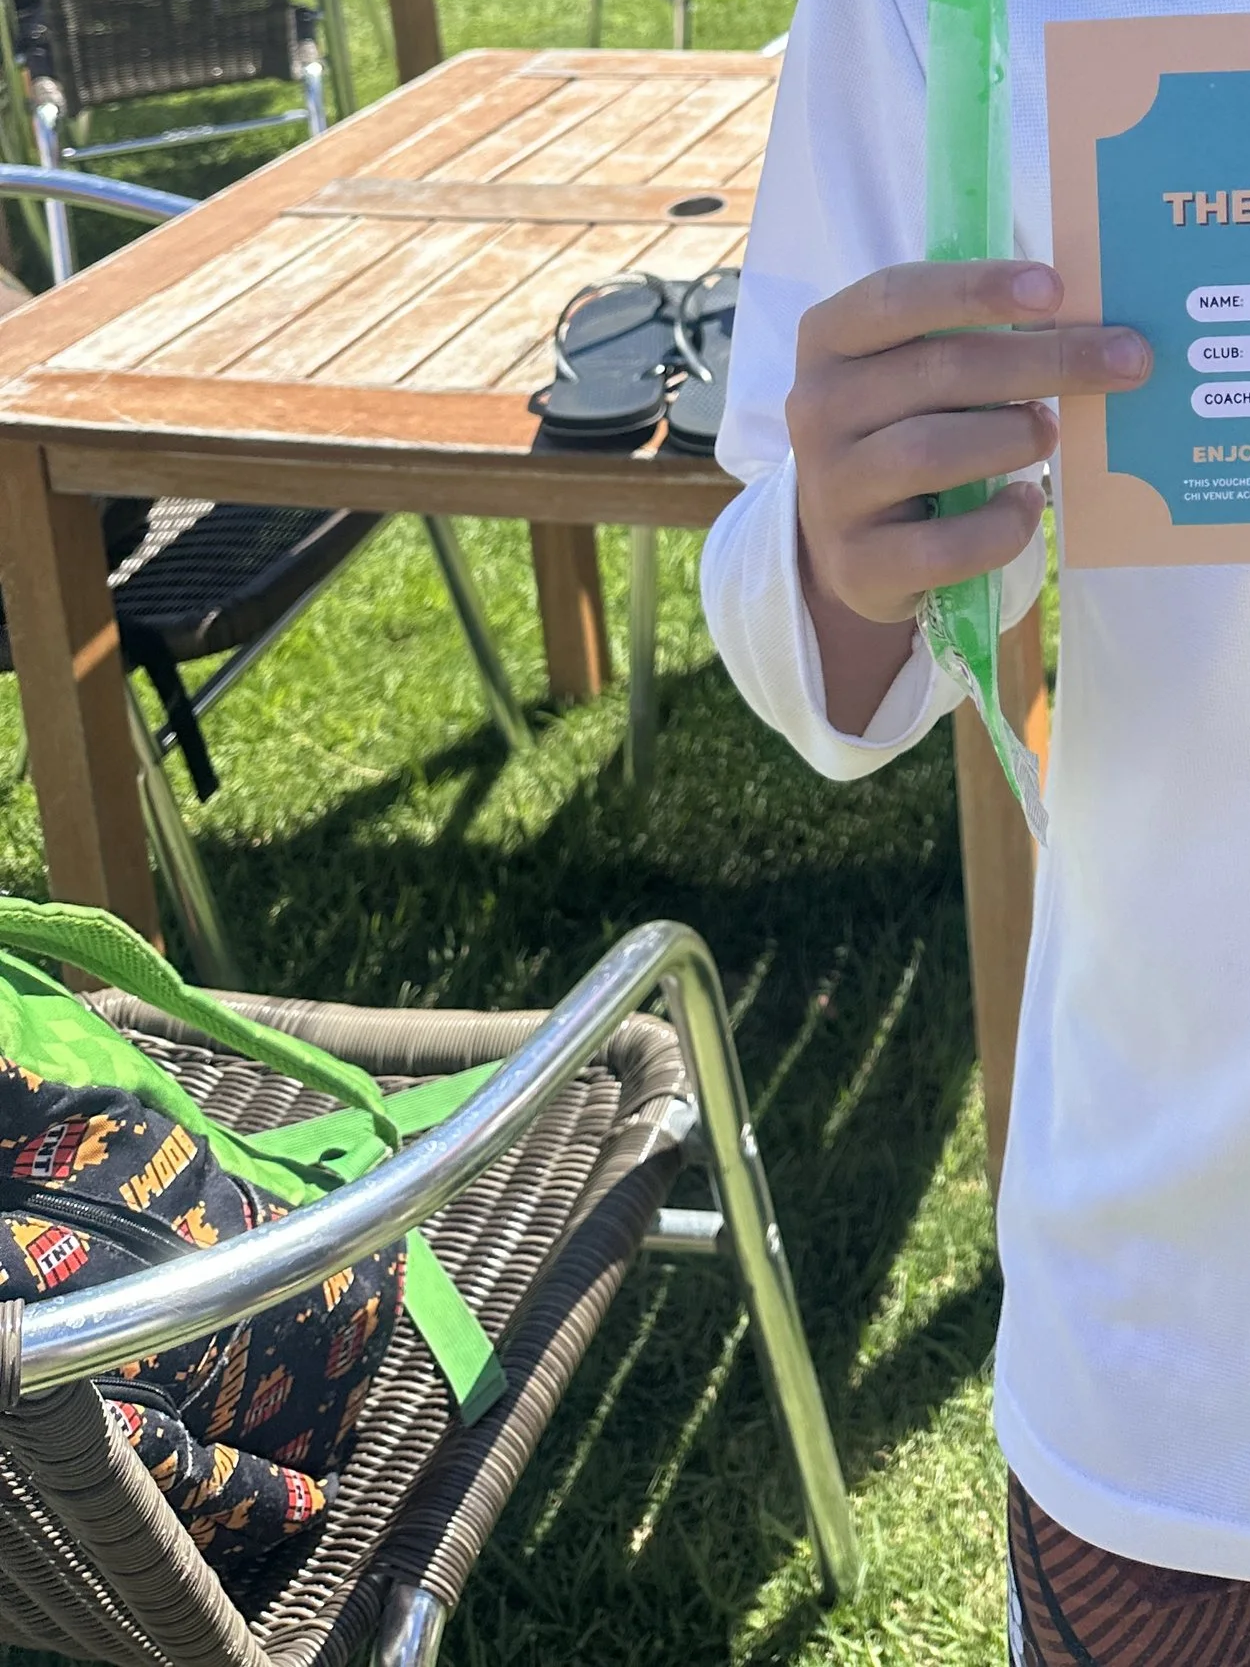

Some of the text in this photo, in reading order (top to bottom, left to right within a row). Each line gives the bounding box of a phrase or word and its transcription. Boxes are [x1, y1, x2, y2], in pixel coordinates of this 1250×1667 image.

[1200, 296, 1244, 309] NAME:
[1203, 348, 1244, 359] CLUB:
[1184, 492, 1201, 501] CHI
[1203, 491, 1234, 501] VENUE
[41, 1238, 76, 1271] TNT
